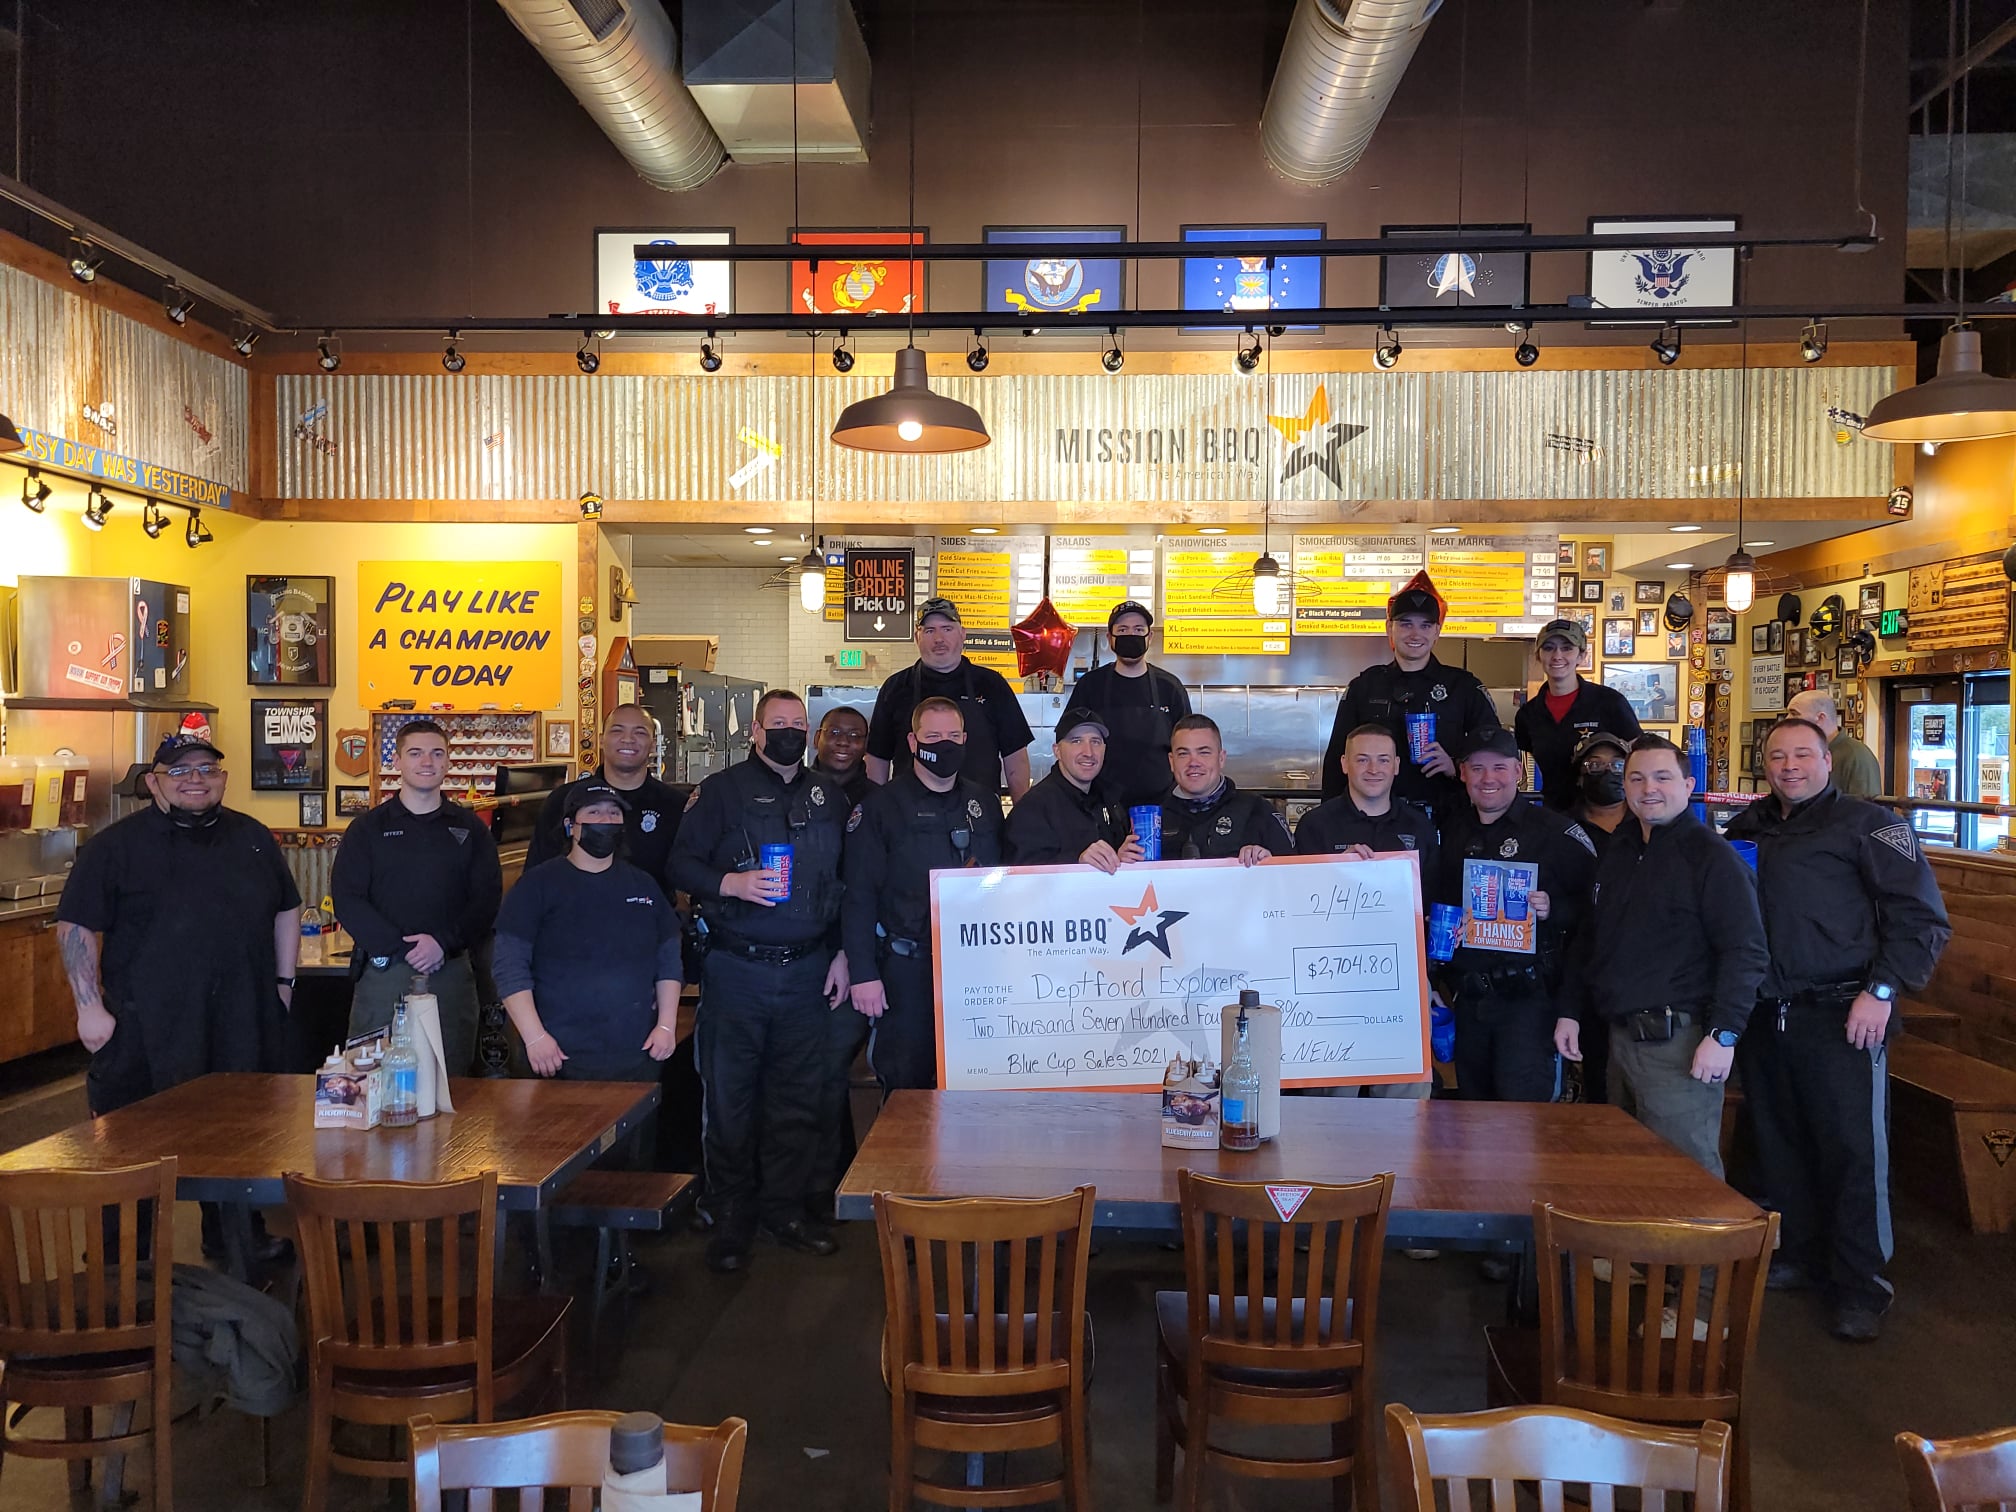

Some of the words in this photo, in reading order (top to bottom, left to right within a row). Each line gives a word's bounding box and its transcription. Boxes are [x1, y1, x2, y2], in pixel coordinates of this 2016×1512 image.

[1055, 429, 1185, 464] MISSION
[1202, 428, 1261, 466] BBQ
[18, 428, 59, 462] ASY
[64, 442, 97, 471] DAY
[102, 453, 137, 484] WAS
[1174, 469, 1232, 481] American
[586, 502, 595, 513] 9
[1894, 496, 1909, 509] 15
[941, 537, 967, 546] SIDES
[1056, 537, 1092, 546] SALADS
[1168, 538, 1228, 547] SANDWICHES
[1299, 537, 1359, 546] SMOKEHOUSE
[1362, 537, 1416, 546] SIGNATURES
[1431, 537, 1456, 546] MEAT
[1458, 537, 1495, 546] MARKET
[854, 559, 905, 578] ONLINE
[134, 579, 140, 593] 2
[1055, 575, 1077, 585] KIDS
[1079, 575, 1105, 585] MENU
[854, 578, 905, 597] ORDER
[375, 582, 463, 613] PLAY
[468, 590, 540, 614] LIKE
[854, 597, 885, 612] Pick
[886, 597, 905, 614] Up
[1340, 610, 1362, 618] Special
[1445, 624, 1468, 632] Sampler
[1882, 610, 1900, 635] EXIT
[1168, 625, 1179, 633] XL
[369, 629, 387, 649] A
[400, 629, 551, 650] CHAMPION
[1168, 641, 1184, 650] XXL
[840, 650, 863, 667] EXIT
[1754, 665, 1766, 673] EVERY
[1766, 664, 1780, 672] BATTLE
[409, 665, 513, 686] TODAY
[1757, 676, 1767, 684] WON
[1763, 686, 1779, 694] FOUGHT
[265, 707, 315, 716] TOWNSHIP
[265, 715, 316, 744] EMS
[1412, 722, 1421, 757] OMETOWN
[1982, 769, 2001, 782] NOW
[1982, 782, 2001, 791] HIRING
[1481, 874, 1489, 917] HOMETOWN
[1488, 875, 1497, 916] HEROES
[1310, 883, 1386, 921] 2/4/22
[1262, 911, 1286, 919] DATE
[960, 920, 1054, 947] MISSION
[1473, 922, 1524, 941] THANKS
[1503, 939, 1513, 947] YOU
[1028, 948, 1044, 957] The
[1046, 947, 1086, 957] American
[1088, 946, 1110, 957] Way.
[1308, 954, 1393, 979] $2,704.80
[982, 986, 993, 994] TO
[994, 985, 1013, 993] THE
[1032, 966, 1146, 1007] Deptford
[1159, 963, 1249, 1004] Explorers
[964, 997, 994, 1006] ORDER
[996, 997, 1008, 1005] OF
[965, 1016, 994, 1038] Two
[998, 1008, 1075, 1034] Thousand
[1082, 1006, 1124, 1033] Seven
[1130, 1002, 1189, 1032] Hundred
[1197, 1004, 1222, 1027] Fou
[1364, 1016, 1404, 1025] DOLLARS
[1008, 1053, 1041, 1075] Blue
[1047, 1051, 1076, 1077] Cup
[1083, 1049, 1128, 1069] Sales
[1133, 1047, 1167, 1065] 2021
[967, 1067, 988, 1075] MEMO
